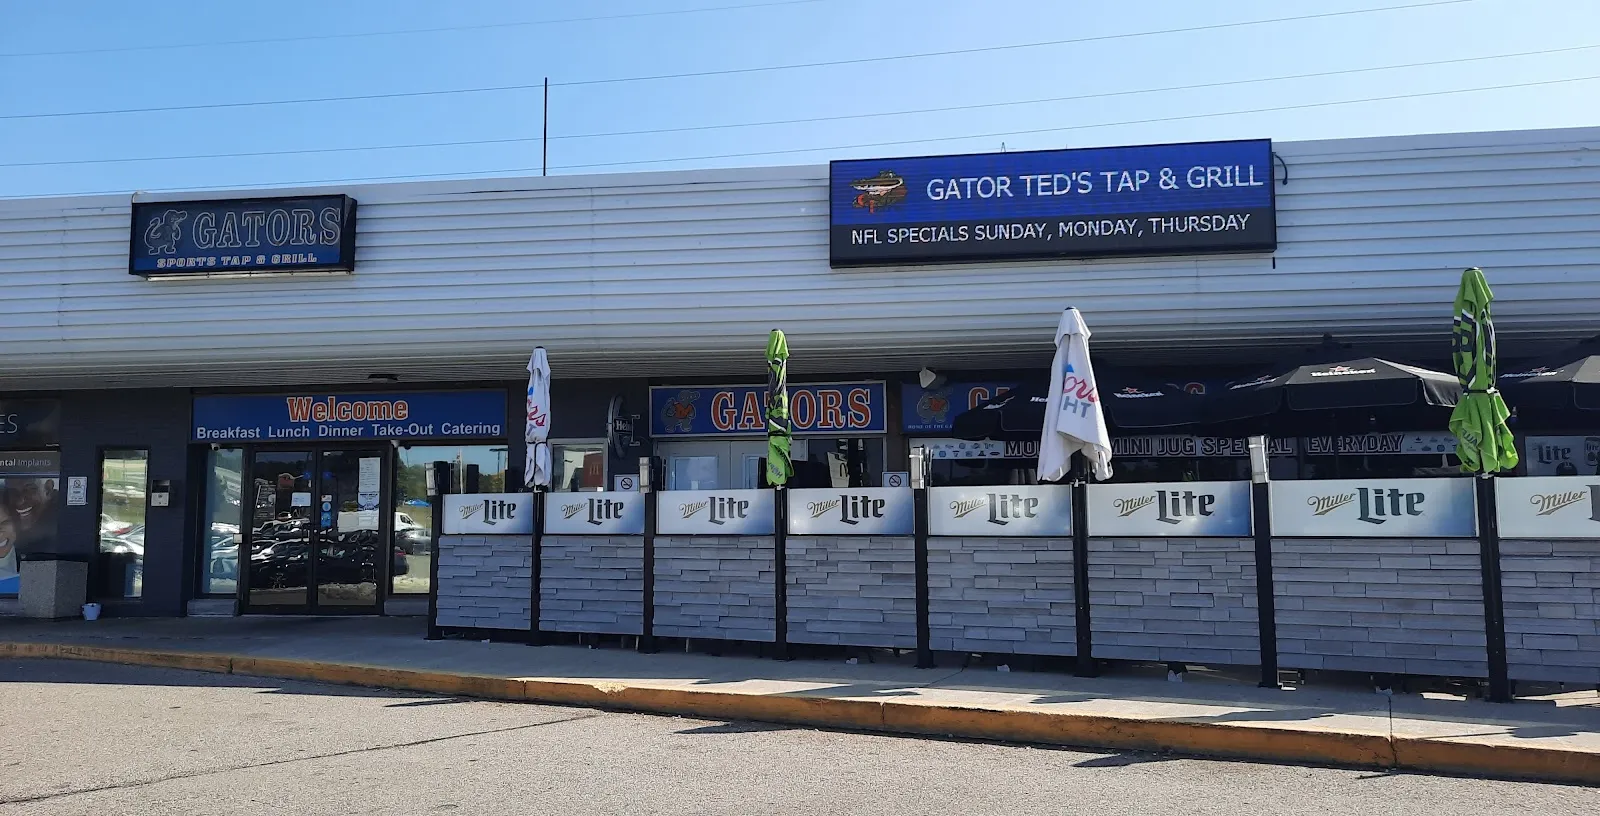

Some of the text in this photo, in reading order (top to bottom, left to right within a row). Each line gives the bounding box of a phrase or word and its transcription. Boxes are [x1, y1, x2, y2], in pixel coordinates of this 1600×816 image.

[926, 164, 1263, 201] GATOR TED'S TAP & GRILL
[192, 207, 341, 249] GATORS
[851, 214, 1250, 245] NFL SPECIALS SUNDAY, MONDAY, THURSDAY
[156, 253, 317, 268] SPORTS TAP & GRILL
[286, 396, 409, 422] Welcome
[711, 388, 871, 430] GAORS
[196, 422, 501, 439] Breakfast Lunch Dinner Take-Out Catering
[1157, 436, 1196, 456] JUG
[18, 458, 52, 468] Implants
[459, 499, 517, 525] Miller Lite
[561, 498, 624, 525] Miller Lite
[679, 496, 749, 525] Miller Lite
[807, 494, 886, 525] Miller Lite
[949, 493, 1039, 526] Miller Lite
[1113, 490, 1215, 525] Miller Lite
[1307, 487, 1425, 525] Miller Lite
[1530, 490, 1587, 516] Miller
